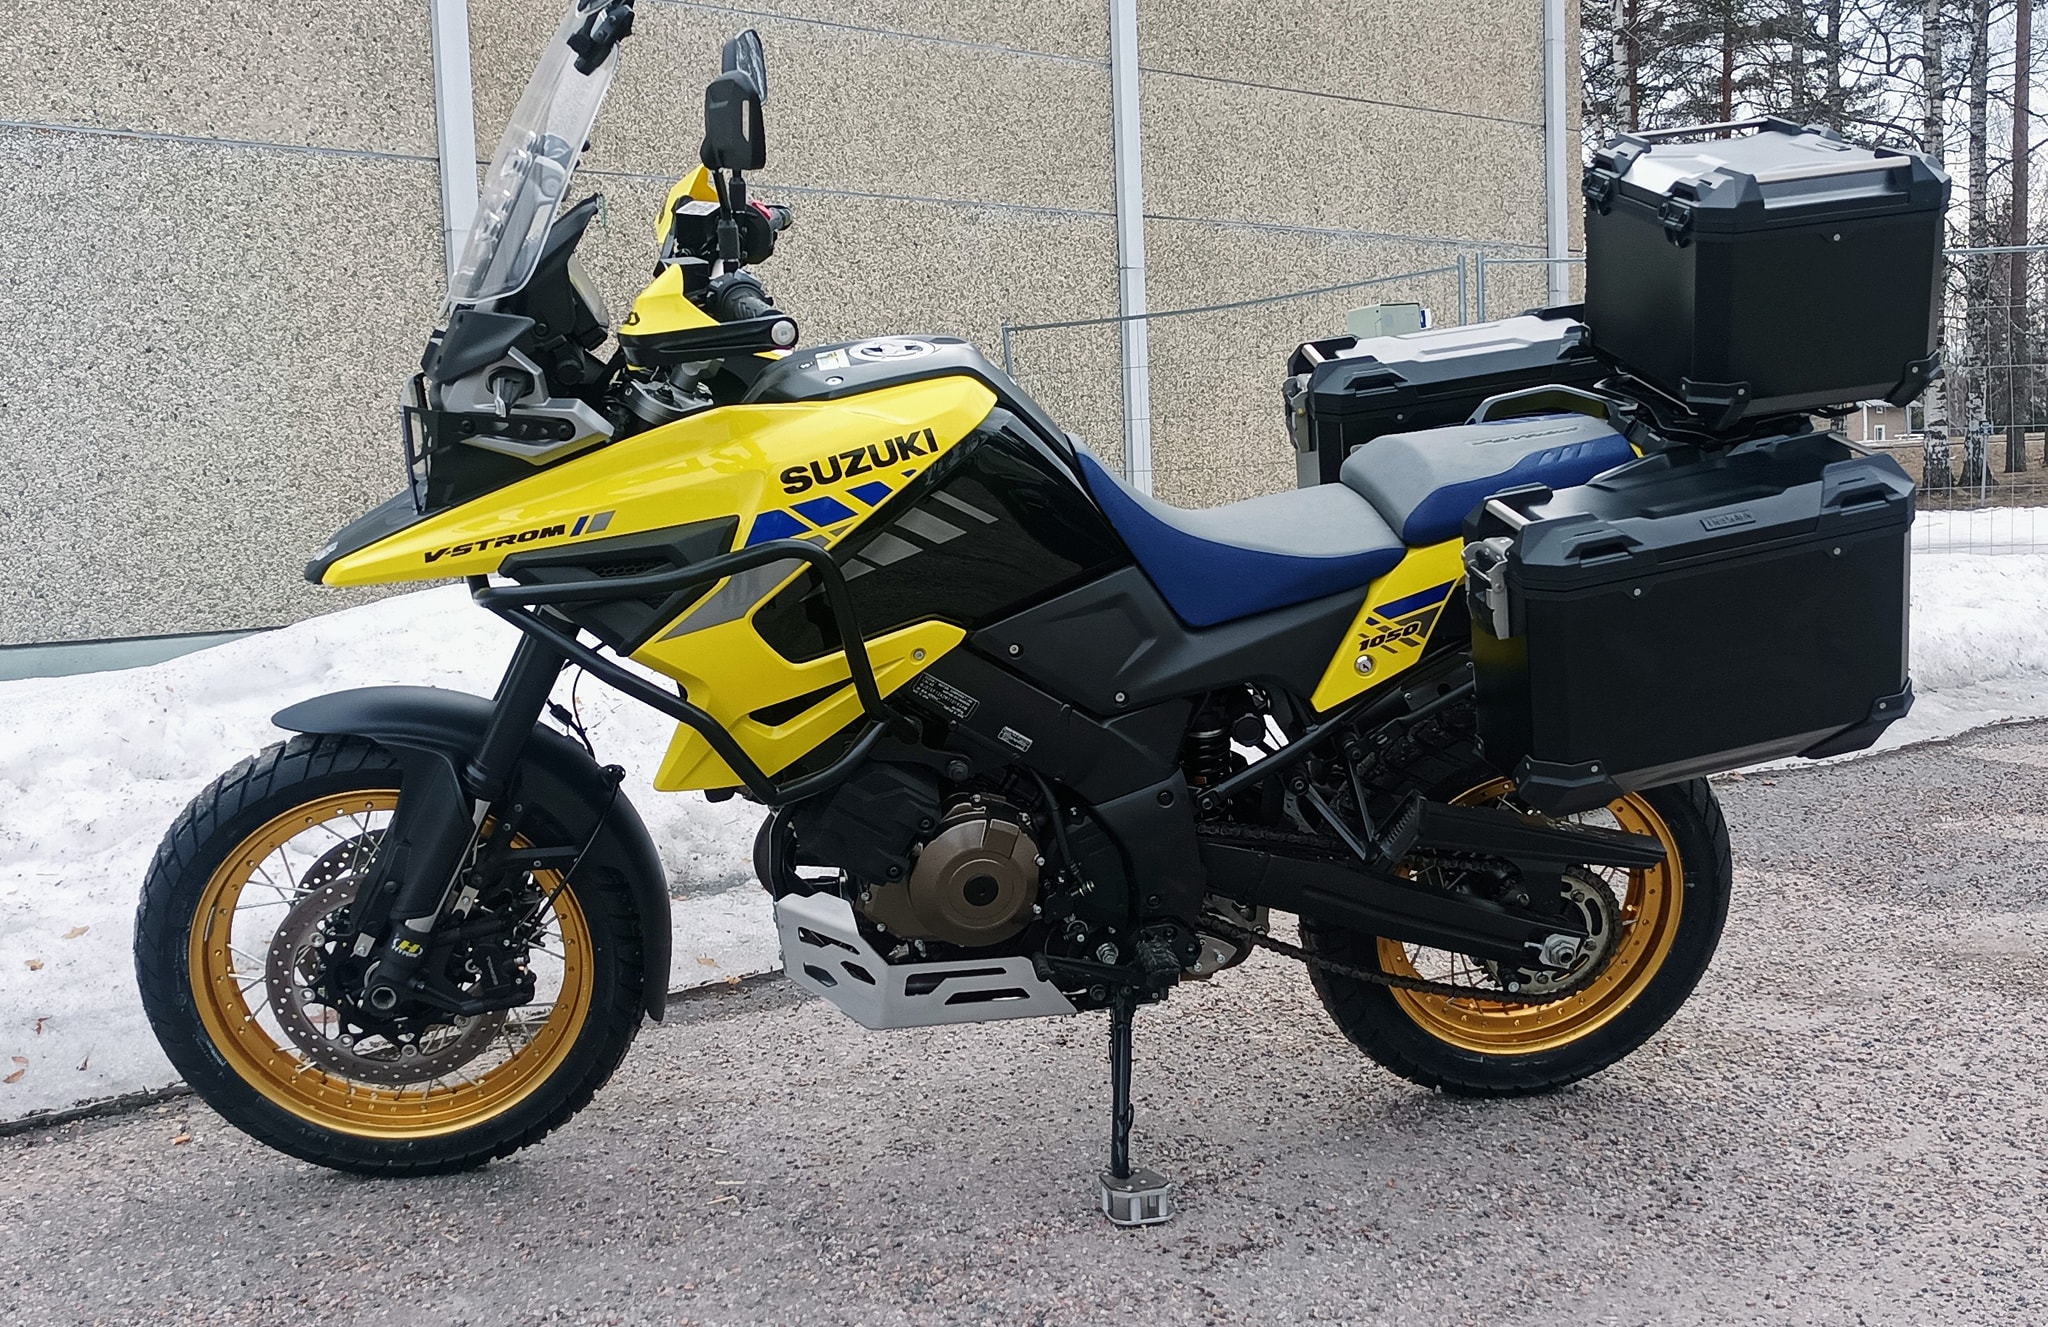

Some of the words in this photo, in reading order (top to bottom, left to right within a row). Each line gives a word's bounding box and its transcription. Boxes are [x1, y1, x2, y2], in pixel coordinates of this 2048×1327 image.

[779, 427, 939, 495] SUZUKI
[424, 523, 566, 564] V-STROM
[1358, 621, 1421, 652] 1050
